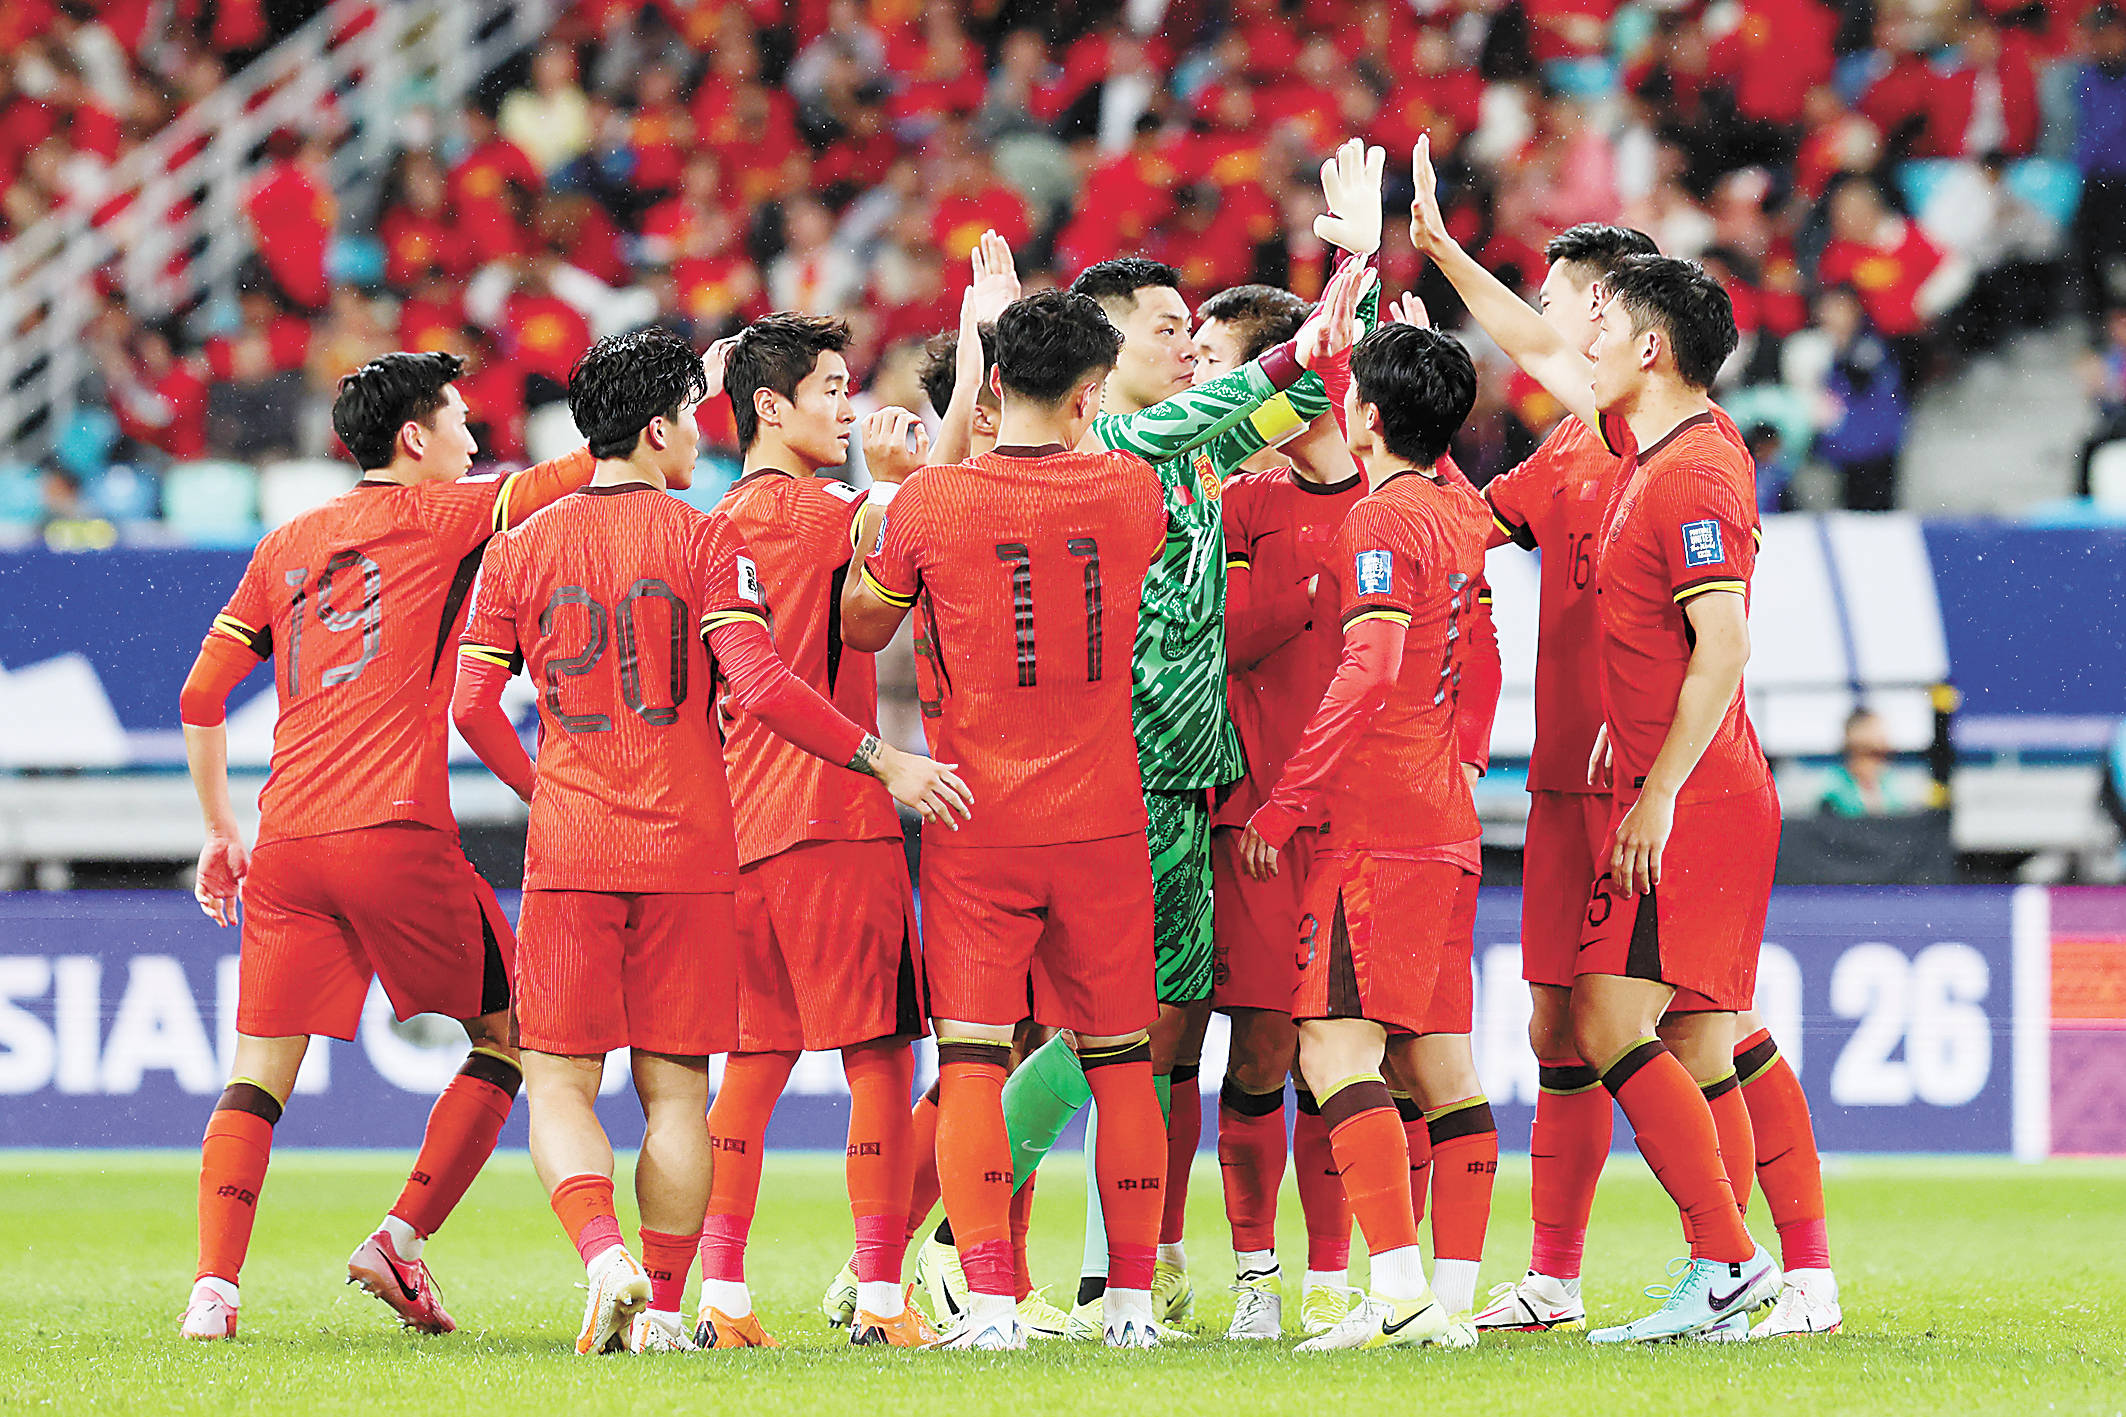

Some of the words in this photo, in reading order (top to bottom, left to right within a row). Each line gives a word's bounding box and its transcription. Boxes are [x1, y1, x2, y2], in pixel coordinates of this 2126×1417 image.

[995, 537, 1102, 687] 11
[1566, 532, 1592, 590] 16
[285, 550, 380, 698] 19
[540, 578, 690, 734] 20
[1296, 913, 1318, 970] 3
[1830, 942, 1992, 1106] 26
[217, 1184, 256, 1206] 中国
[1117, 1177, 1159, 1191] 中国
